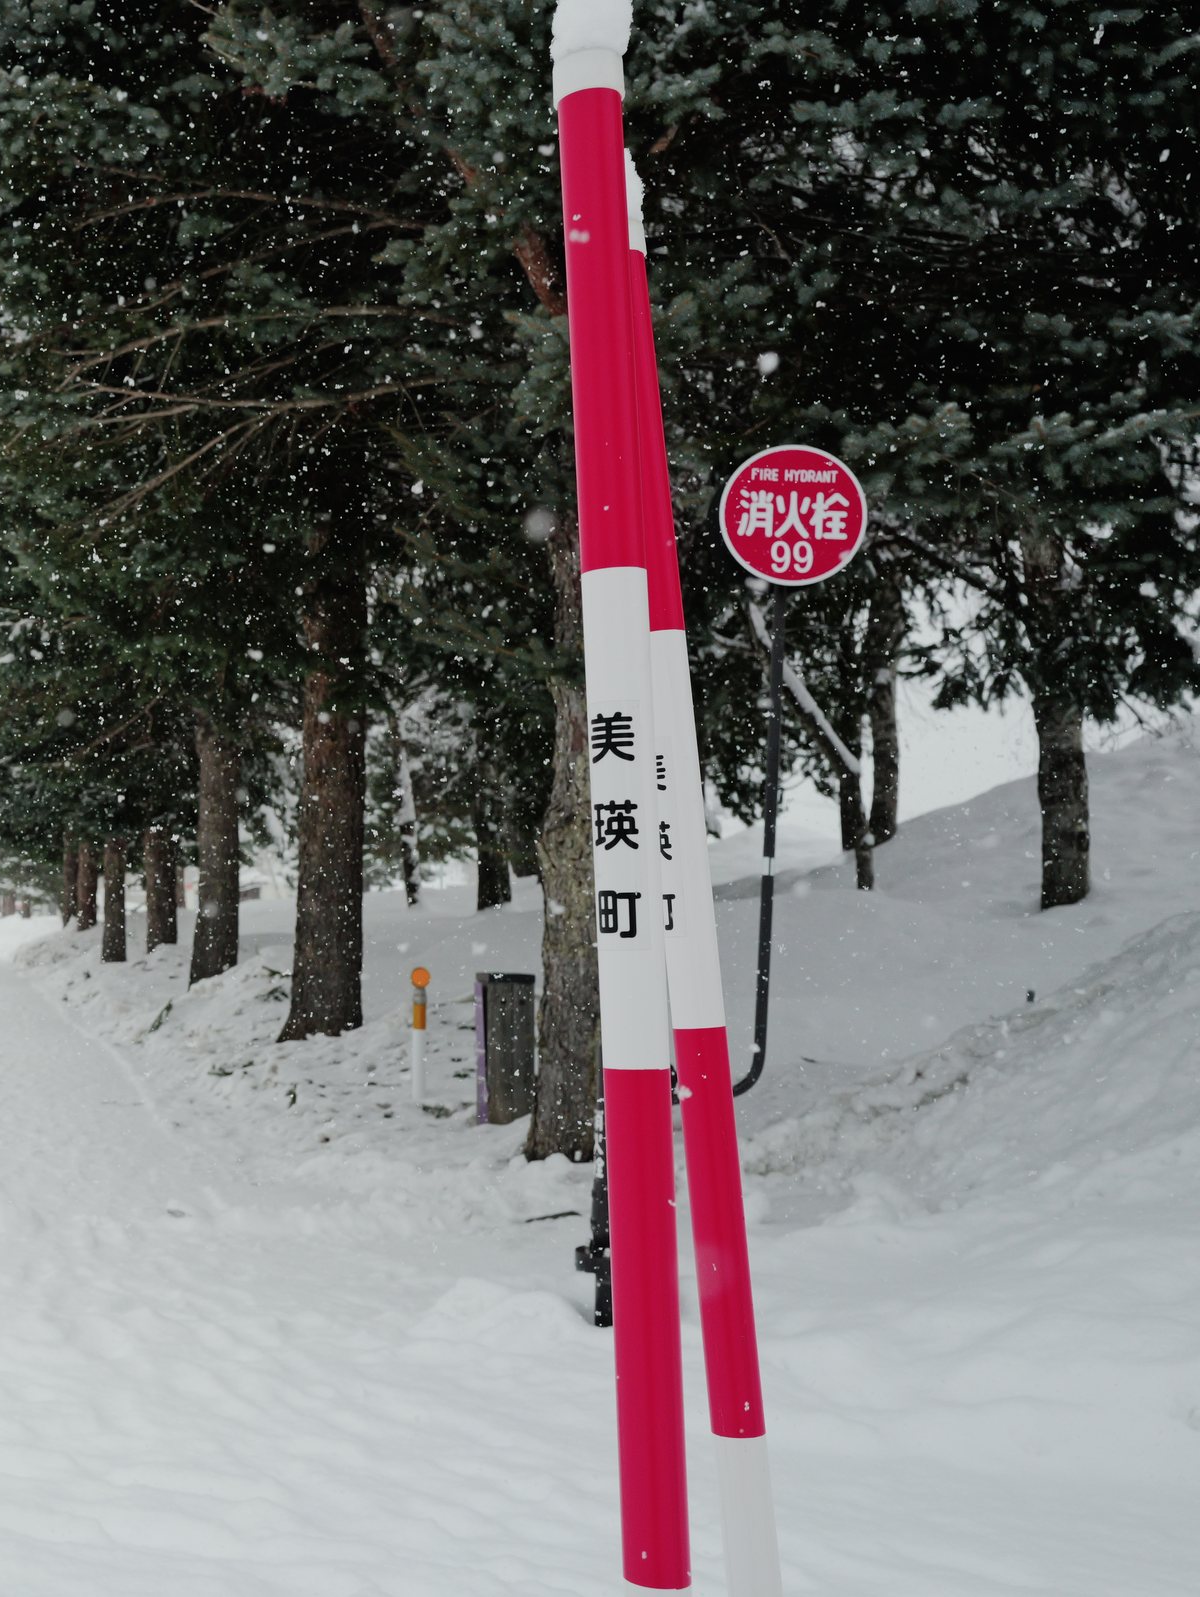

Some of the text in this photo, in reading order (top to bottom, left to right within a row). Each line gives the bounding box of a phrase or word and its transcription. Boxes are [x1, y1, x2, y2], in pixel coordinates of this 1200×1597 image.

[751, 467, 838, 483] FIRE HYDRANT
[737, 489, 850, 540] 消火栓
[770, 540, 814, 574] 99
[591, 712, 641, 938] 美瑛町
